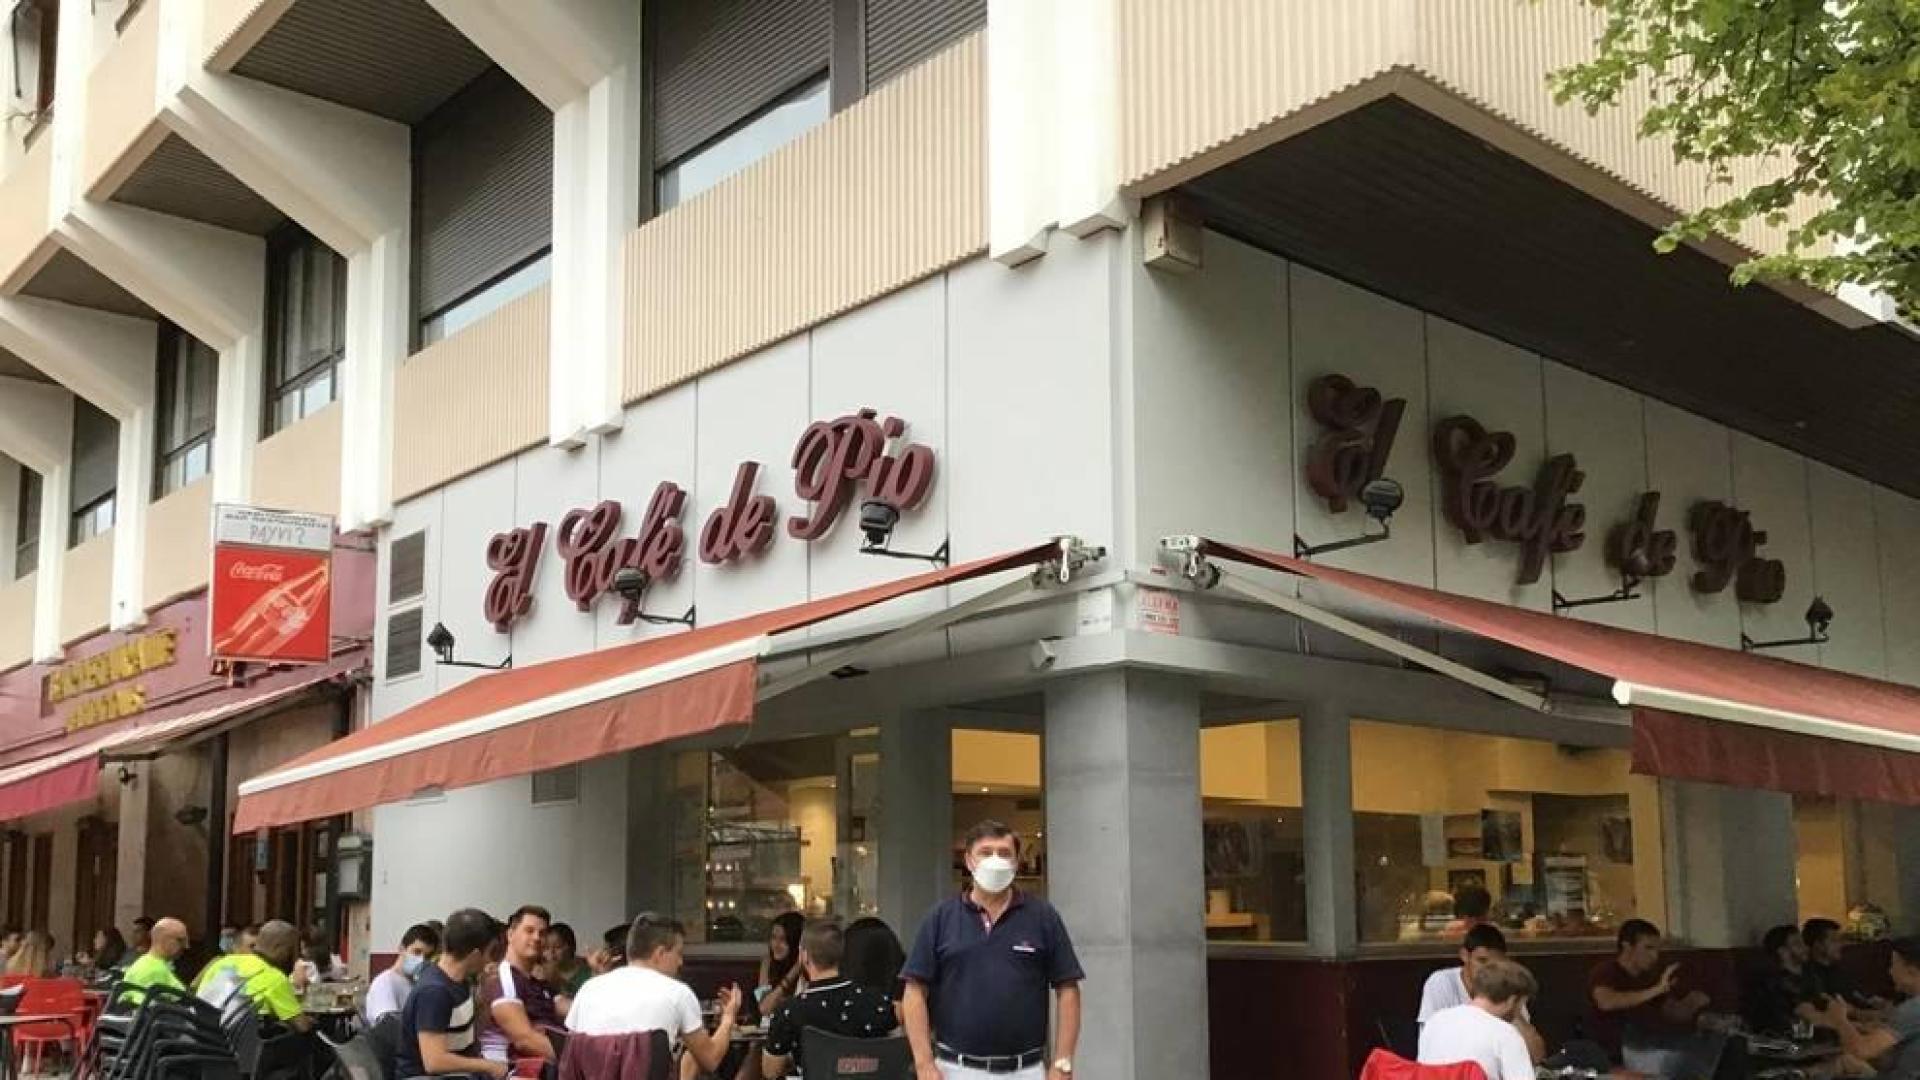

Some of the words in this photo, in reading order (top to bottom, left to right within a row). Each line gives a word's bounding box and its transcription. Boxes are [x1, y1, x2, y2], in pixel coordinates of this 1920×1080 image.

[485, 522, 547, 634] El
[699, 461, 776, 565] de
[1306, 373, 1405, 513] El
[1606, 492, 1677, 576] de
[229, 560, 285, 581] Coca-Cola
